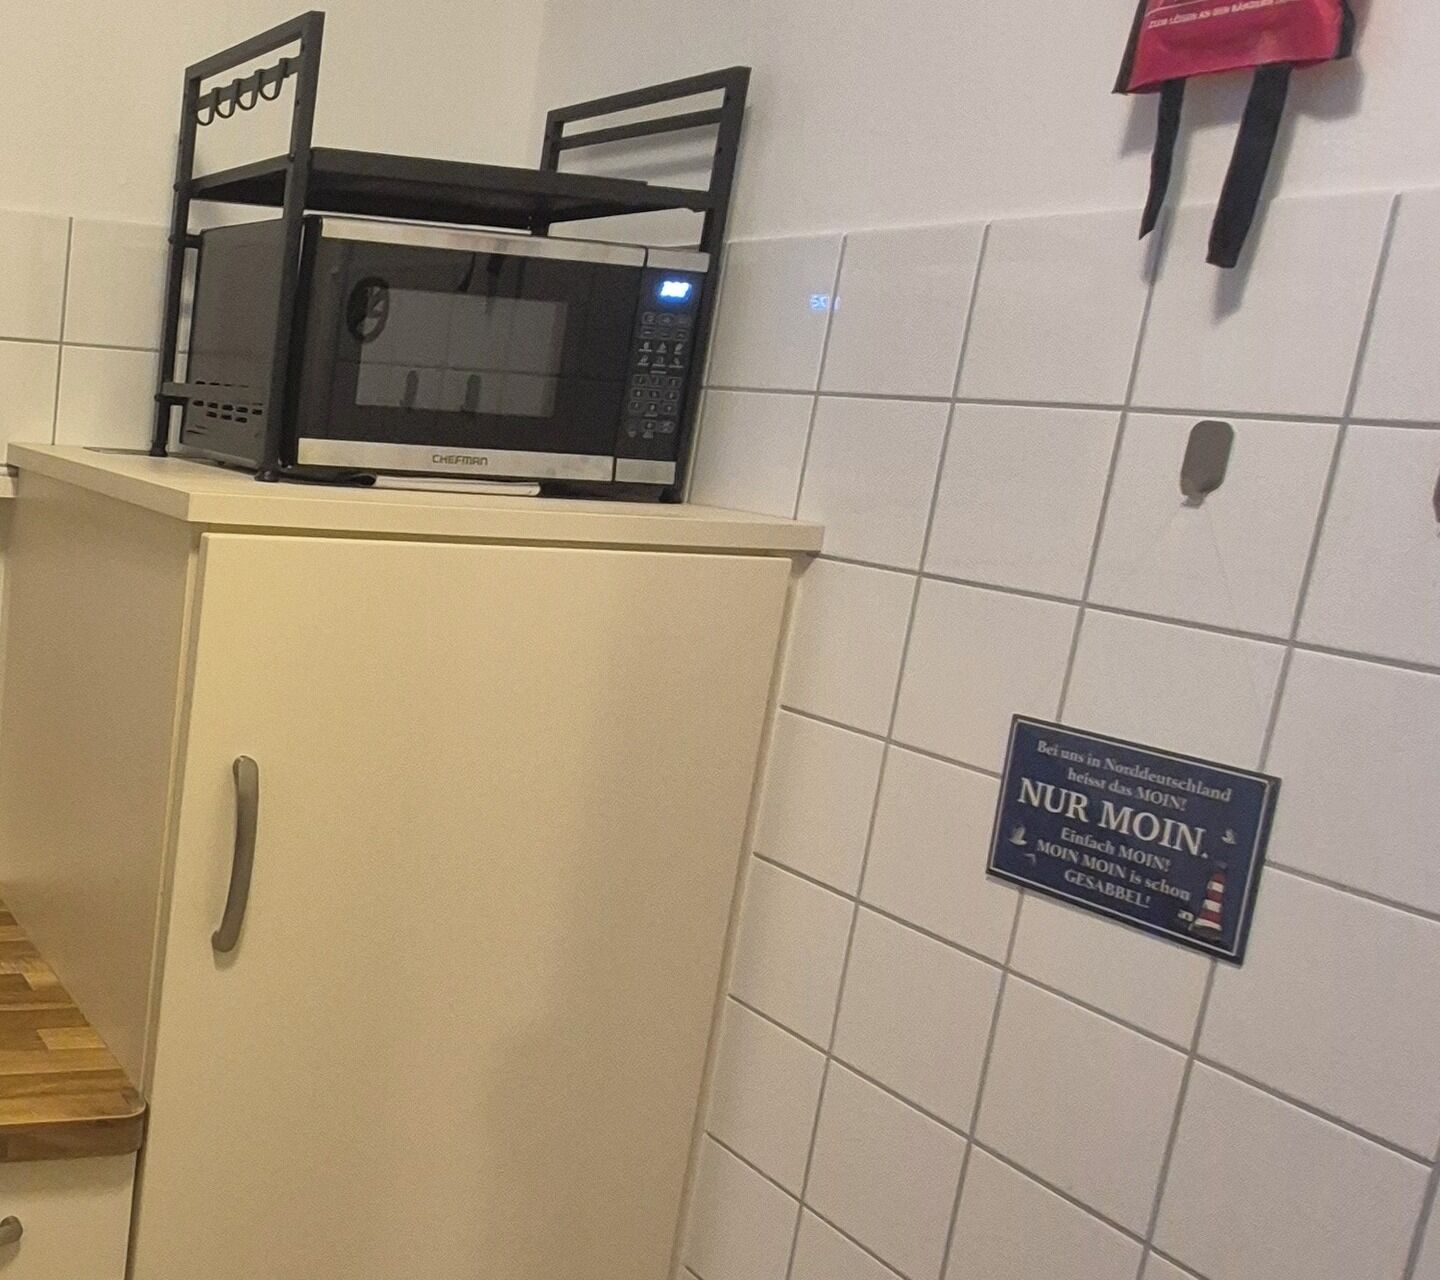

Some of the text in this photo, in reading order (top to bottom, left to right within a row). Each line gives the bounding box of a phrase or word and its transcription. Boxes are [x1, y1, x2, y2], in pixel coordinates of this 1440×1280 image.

[432, 454, 489, 466] CHEFMAN
[1037, 740, 1233, 802] Bei uns in Norddeutschland
[1067, 767, 1188, 812] heisst das MOIN!
[1017, 776, 1209, 859] NUR MOIN.
[1036, 839, 1192, 902] MOIN MOIN is schon
[1060, 826, 1171, 873] Einfach MOIN!
[1063, 868, 1152, 909] GESABBEL!
